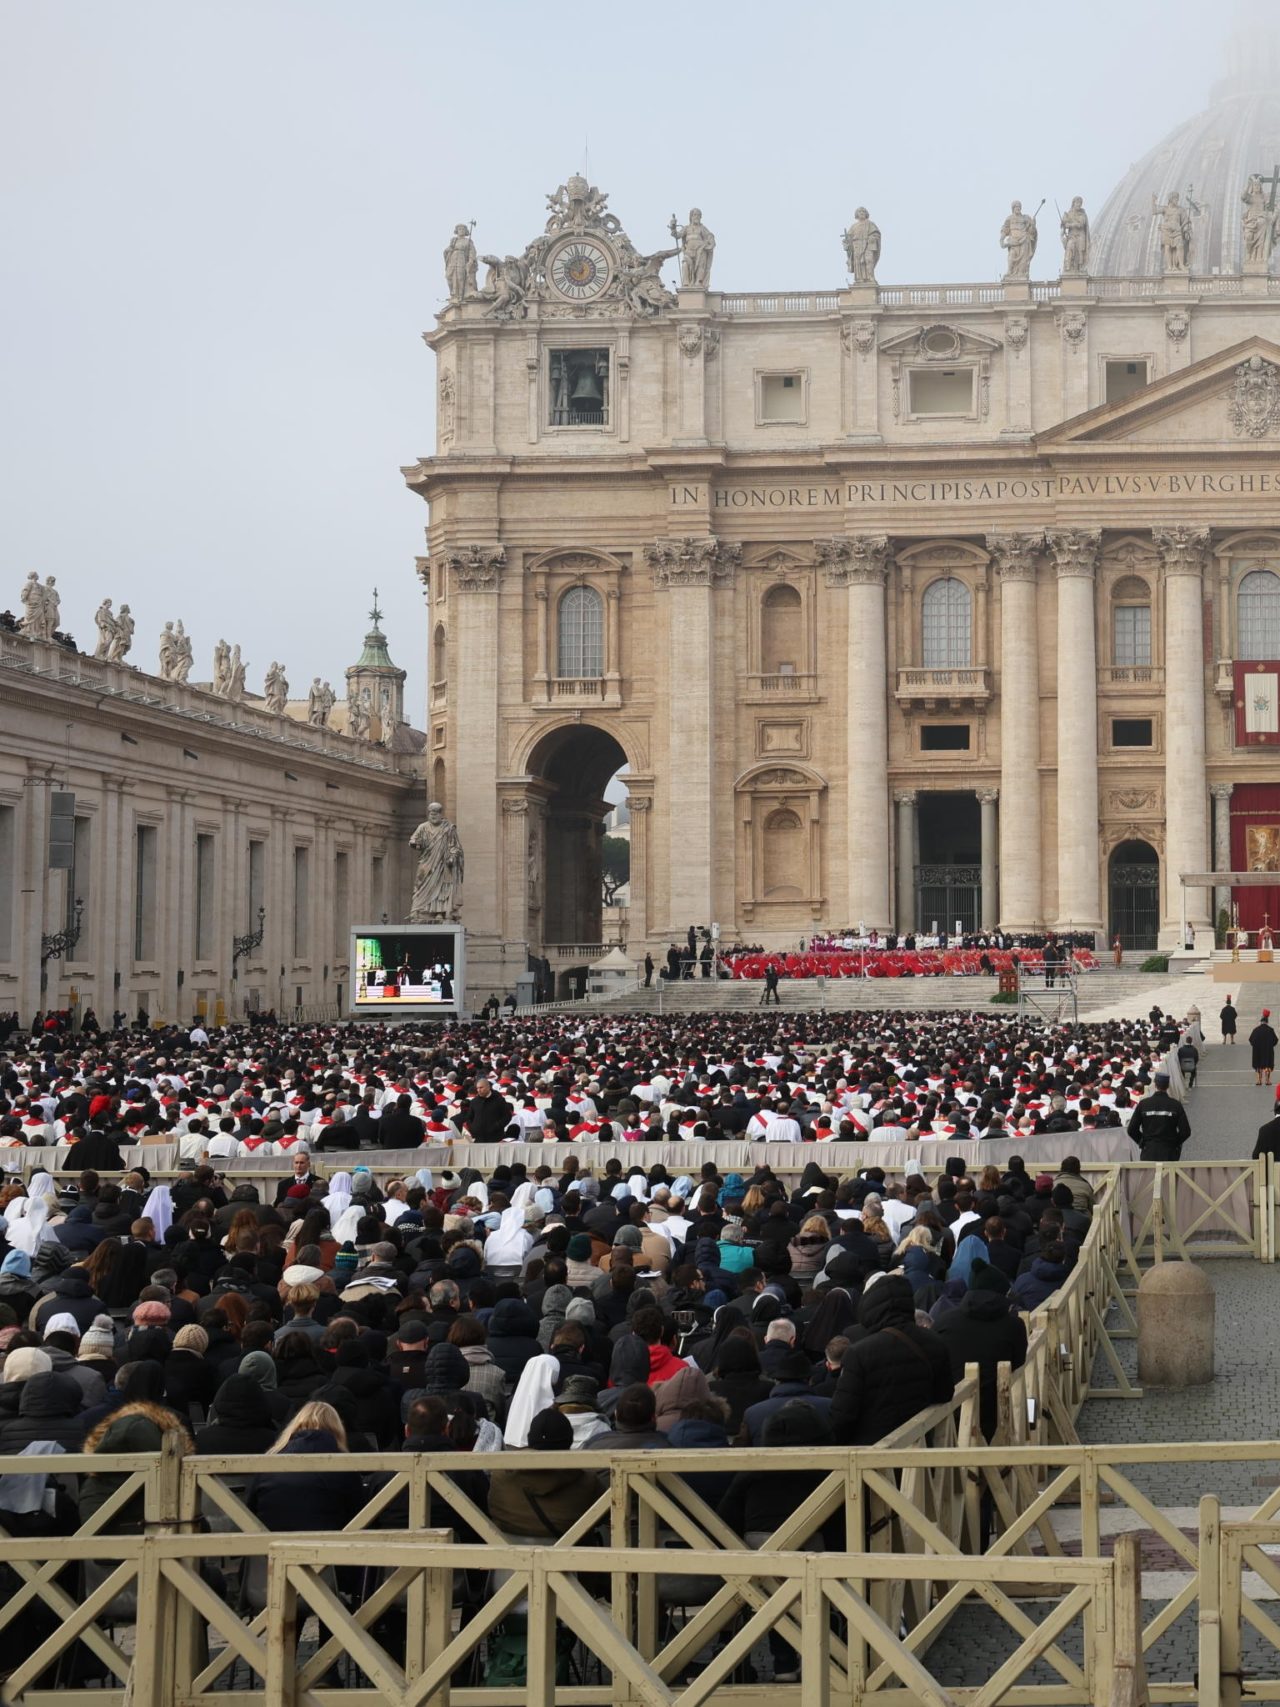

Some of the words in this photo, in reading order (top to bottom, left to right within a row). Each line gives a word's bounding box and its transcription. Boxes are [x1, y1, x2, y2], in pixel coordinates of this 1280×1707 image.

[672, 487, 699, 504] IN
[715, 488, 840, 507] HONOREM
[848, 482, 973, 501] PRINCIPIS
[978, 480, 1056, 499] APOST
[1059, 476, 1141, 494] PAVLVS
[1148, 475, 1162, 493] V
